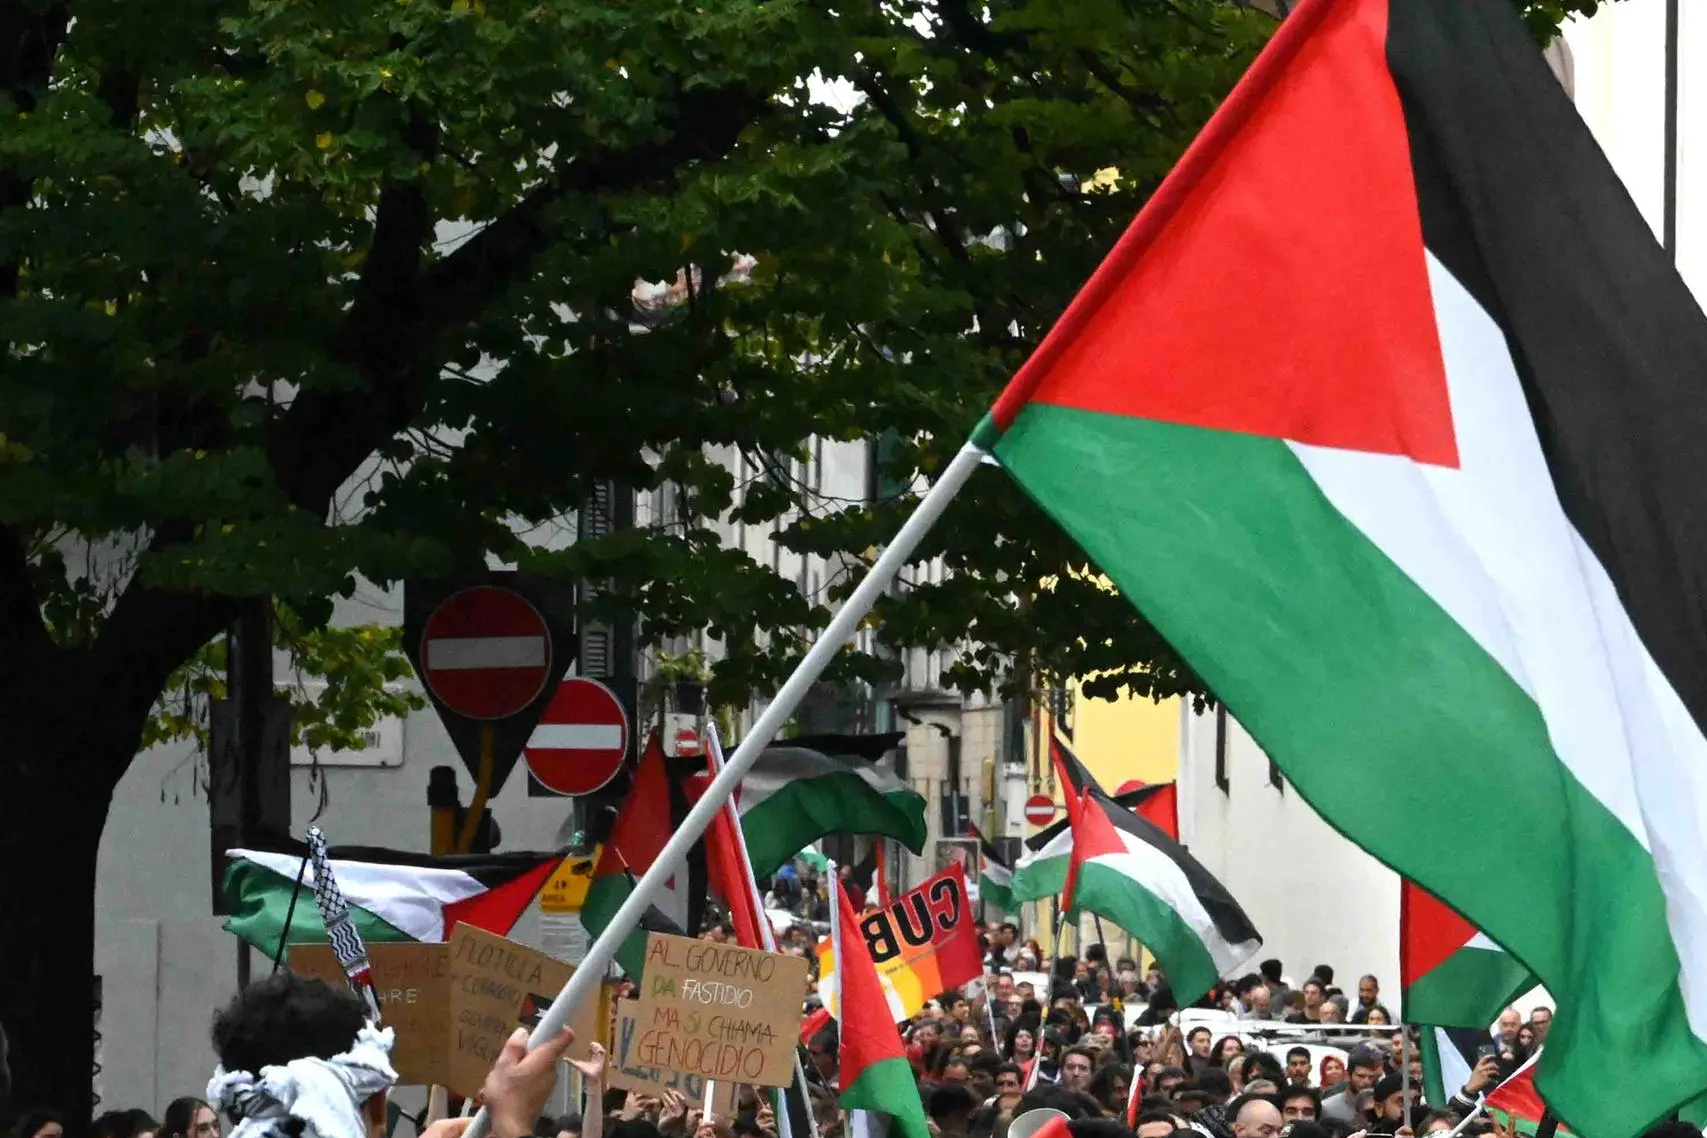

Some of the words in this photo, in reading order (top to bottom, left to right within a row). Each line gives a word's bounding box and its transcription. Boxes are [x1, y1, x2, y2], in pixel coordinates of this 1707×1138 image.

[650, 939, 680, 968] AL
[686, 944, 776, 982] GOVERNO
[682, 979, 753, 1008] FASTIDIO
[653, 1007, 681, 1031] MA
[708, 1015, 778, 1047] CHIAMA
[637, 1030, 765, 1079] GENOCIDIO
